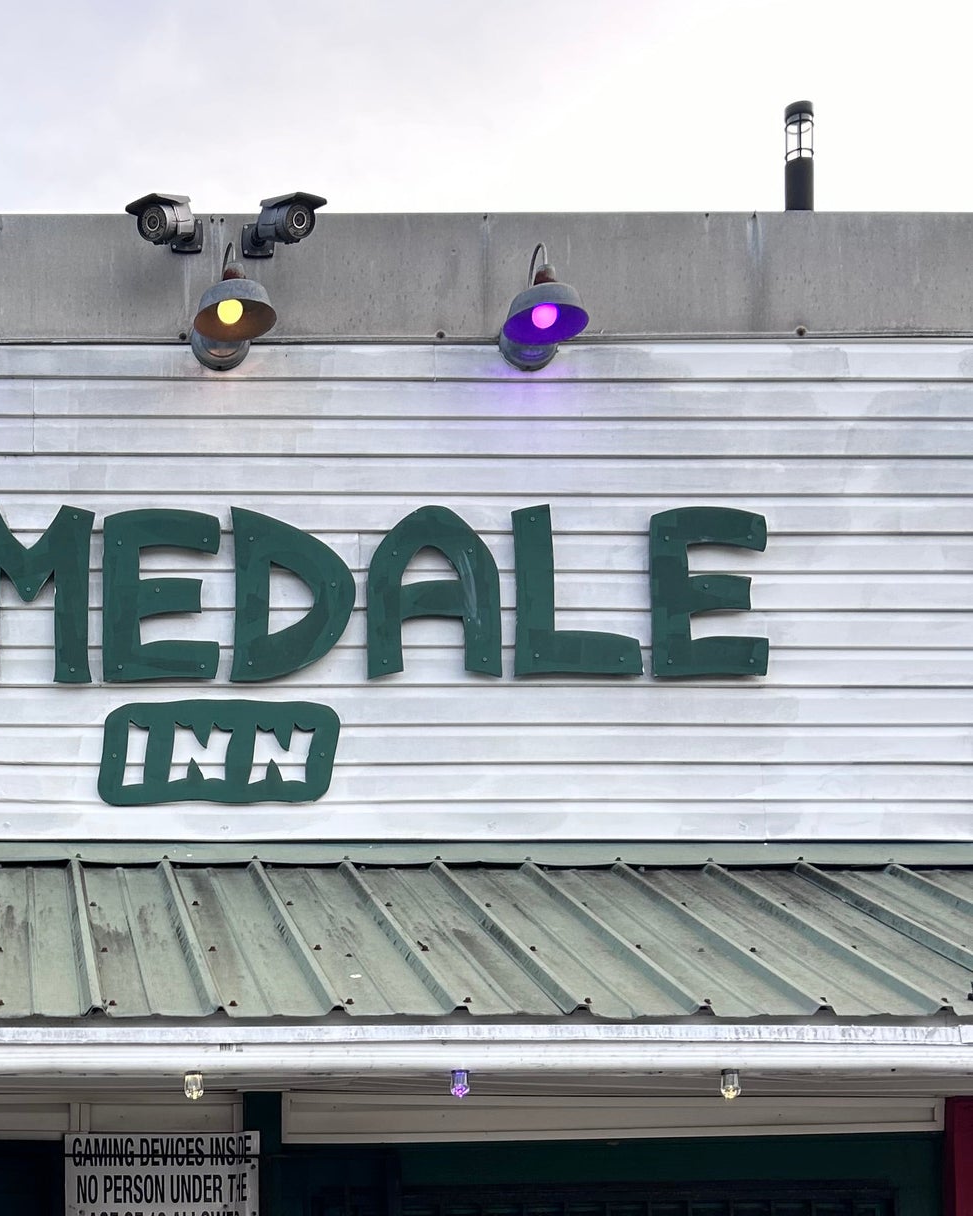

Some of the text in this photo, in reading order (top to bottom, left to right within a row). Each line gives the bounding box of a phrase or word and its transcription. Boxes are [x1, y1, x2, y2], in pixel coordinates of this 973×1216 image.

[123, 715, 319, 791] INN
[72, 1137, 134, 1167] GAMING
[139, 1136, 205, 1167] DEVICES
[77, 1175, 98, 1204] NO
[104, 1174, 165, 1204] PERSON
[170, 1174, 223, 1203] UNDER
